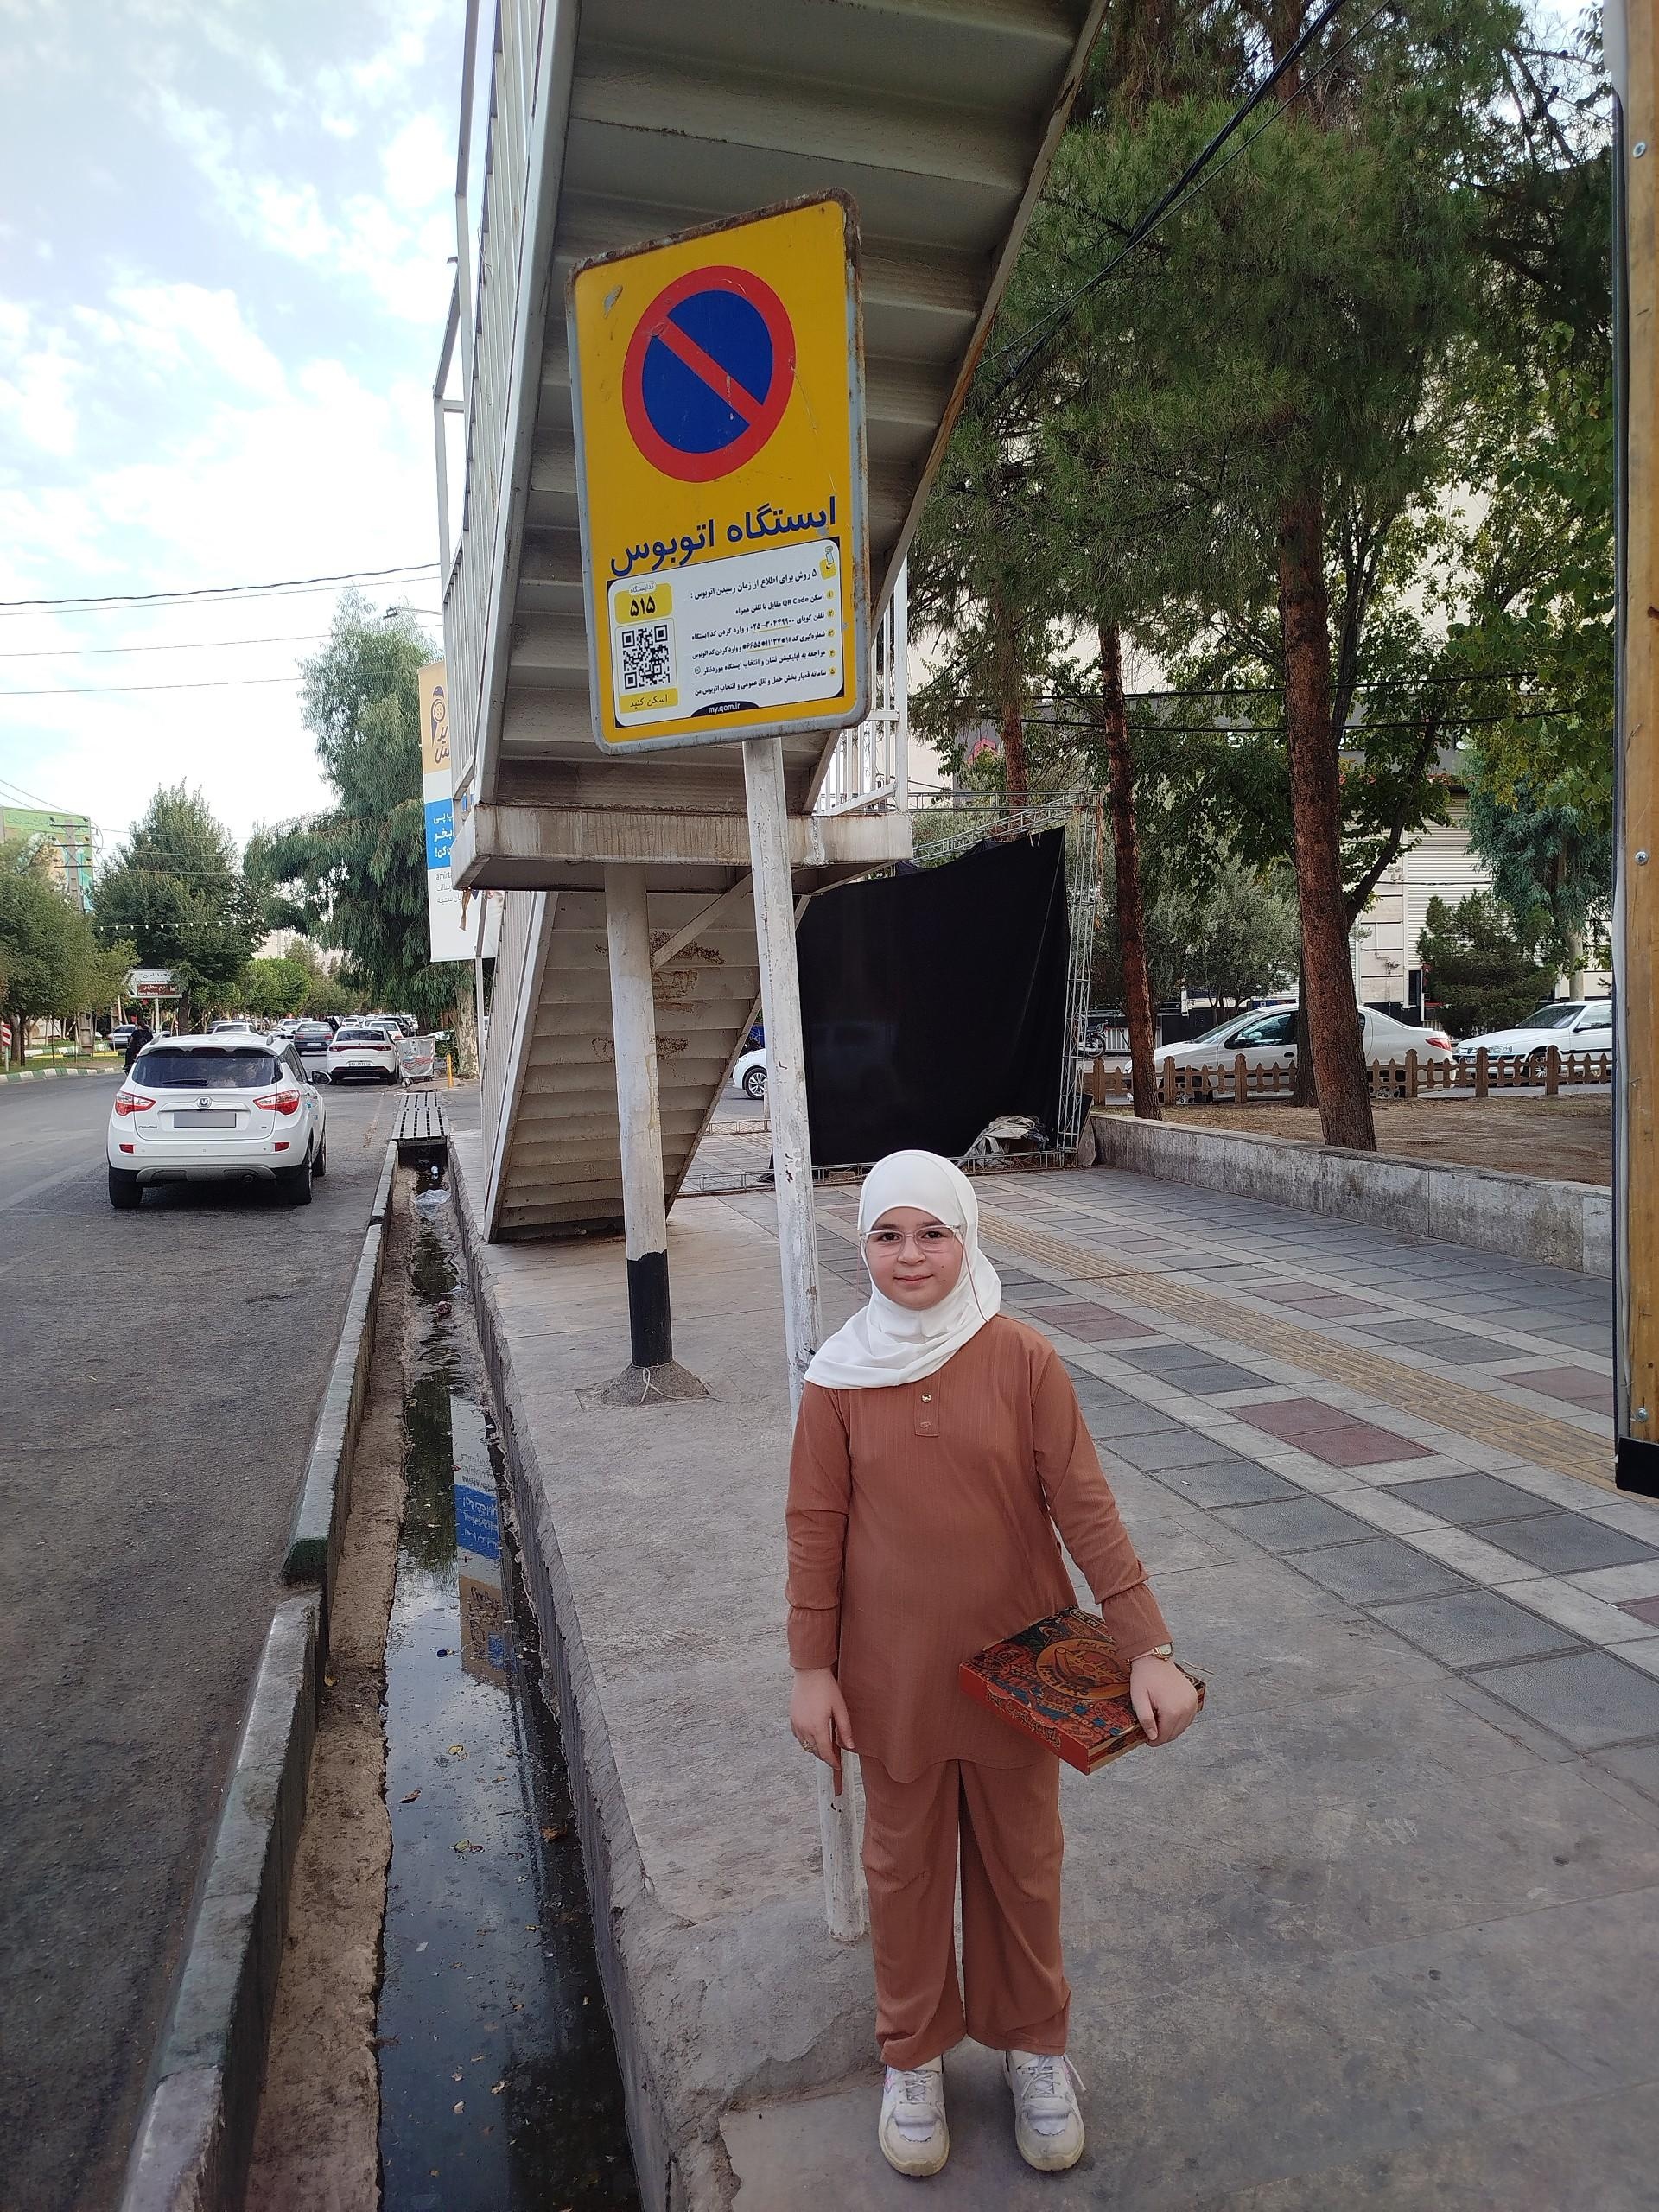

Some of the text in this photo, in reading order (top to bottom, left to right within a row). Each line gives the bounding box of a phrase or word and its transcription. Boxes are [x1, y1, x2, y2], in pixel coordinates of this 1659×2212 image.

[610, 496, 836, 577] ایستگاه اتوبوس
[779, 575, 793, 585] برای
[795, 571, 810, 582] روش
[738, 582, 752, 592] زمان
[753, 580, 759, 589] از
[761, 576, 778, 588] اطلاع
[695, 588, 715, 600] اتوبوس
[716, 585, 735, 596] رسیدن
[810, 593, 824, 603] اسکن
[630, 595, 655, 617] ۵۱۵
[751, 605, 761, 613] تلفن
[768, 601, 781, 610] مقابل
[735, 607, 749, 615] همراه
[813, 612, 824, 620] تلفن
[717, 628, 732, 637] کردن
[734, 626, 744, 635] وارد
[692, 650, 709, 660] اتوبوس
[716, 647, 728, 656] کردن
[808, 650, 825, 658] مراجعه
[766, 657, 778, 665] نشان
[779, 652, 800, 663] اپلیکیشن
[724, 662, 742, 671] ایستگاه
[743, 658, 760, 668] انتخاب
[702, 685, 720, 695] اتوبوس
[720, 683, 735, 691] انتخاب
[741, 680, 757, 690] عمومی
[630, 694, 668, 709] اسکن کنید
[708, 702, 741, 714] my.qom.ir
